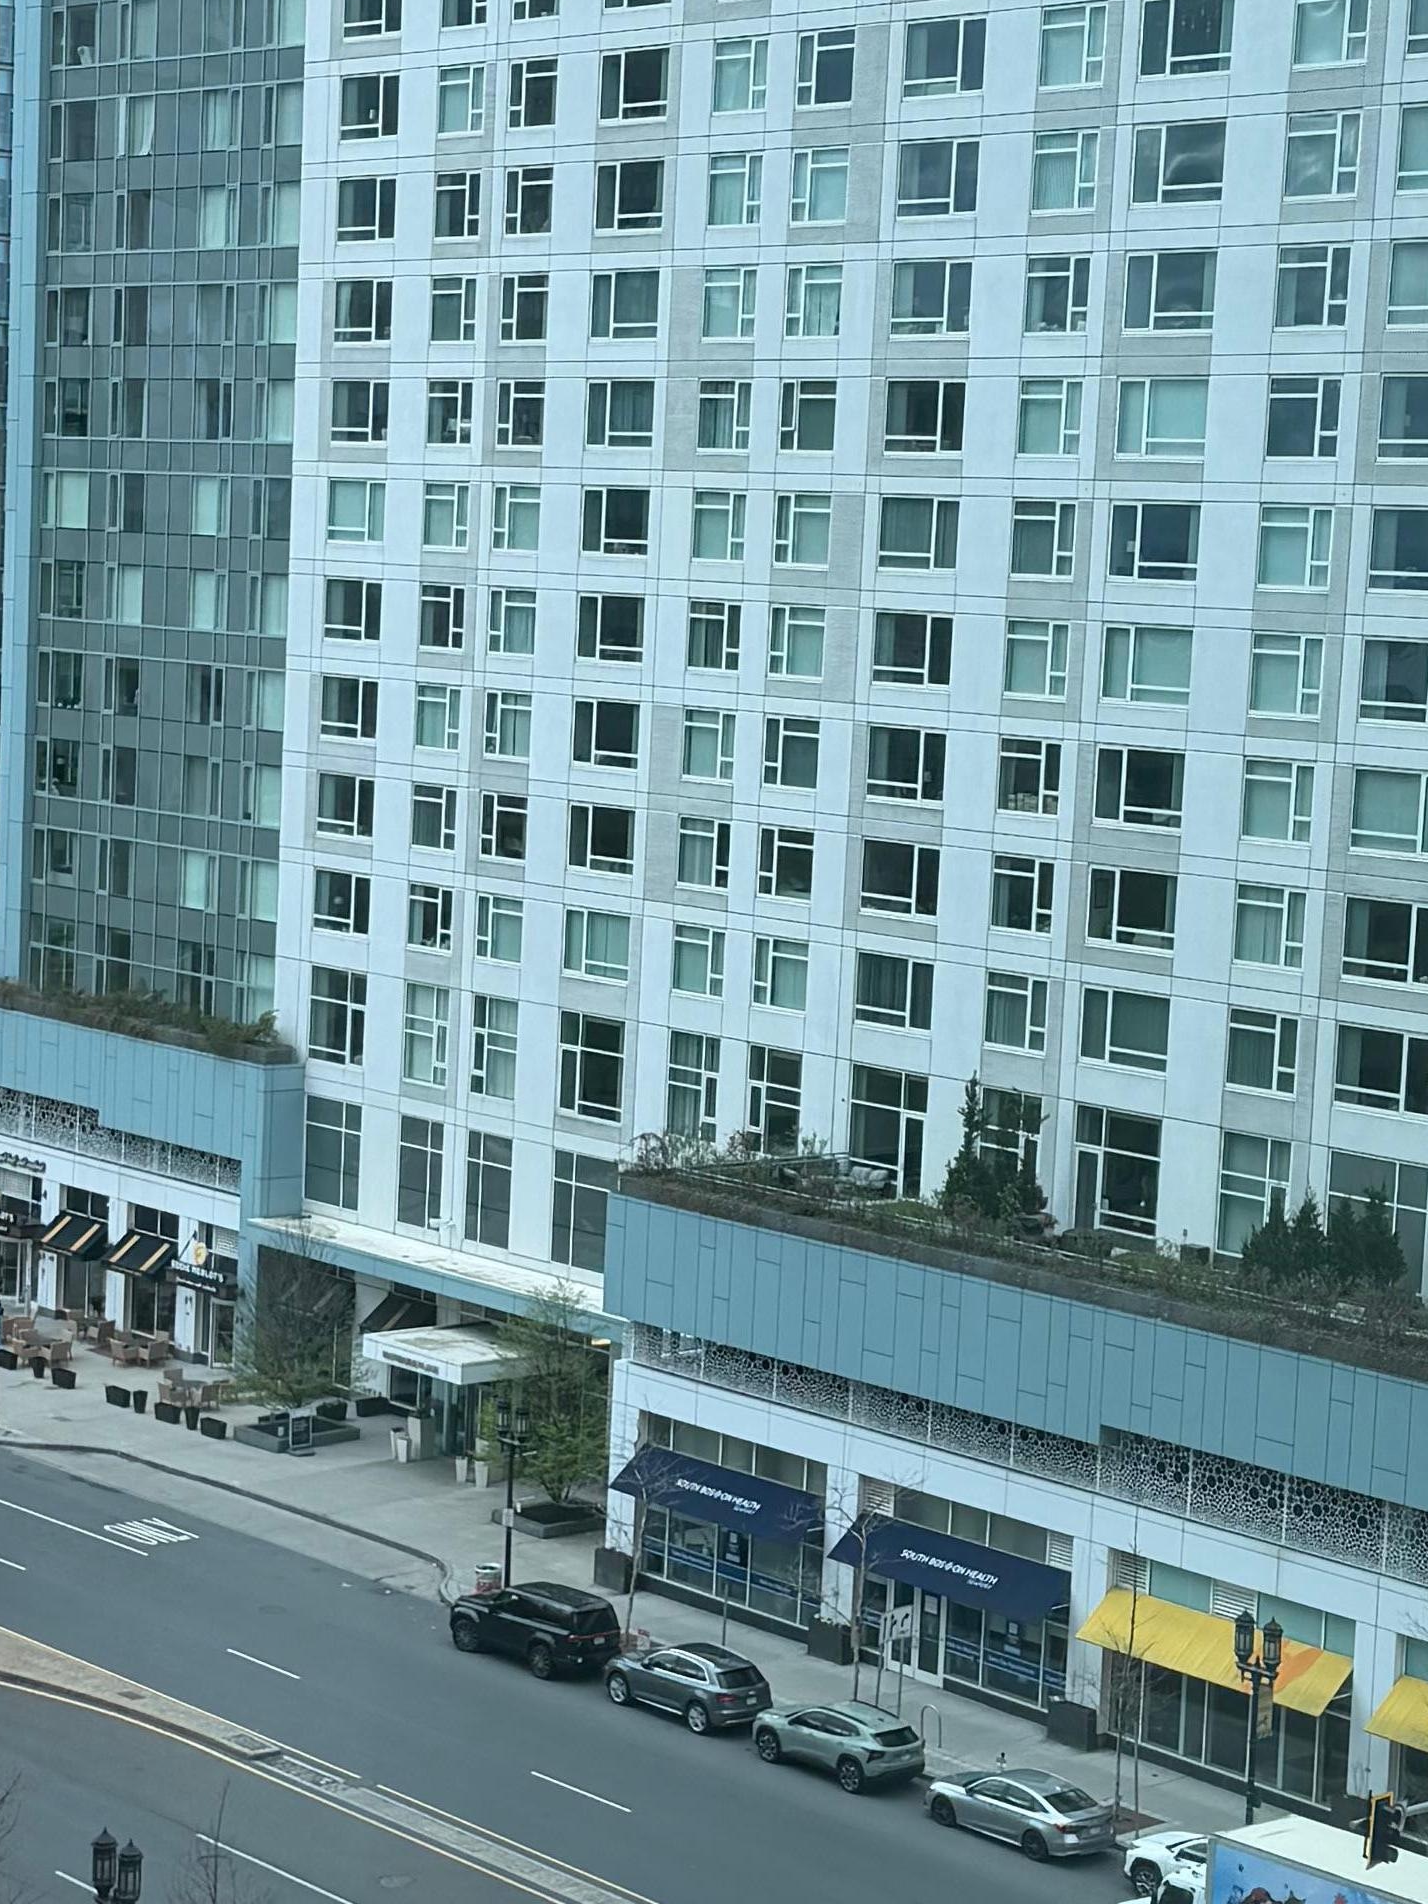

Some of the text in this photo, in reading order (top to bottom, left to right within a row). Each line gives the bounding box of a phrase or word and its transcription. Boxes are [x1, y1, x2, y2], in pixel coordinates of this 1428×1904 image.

[103, 1517, 199, 1545] ONLY
[900, 1549, 929, 1564] SOUTH
[965, 1569, 999, 1585] HEALTH
